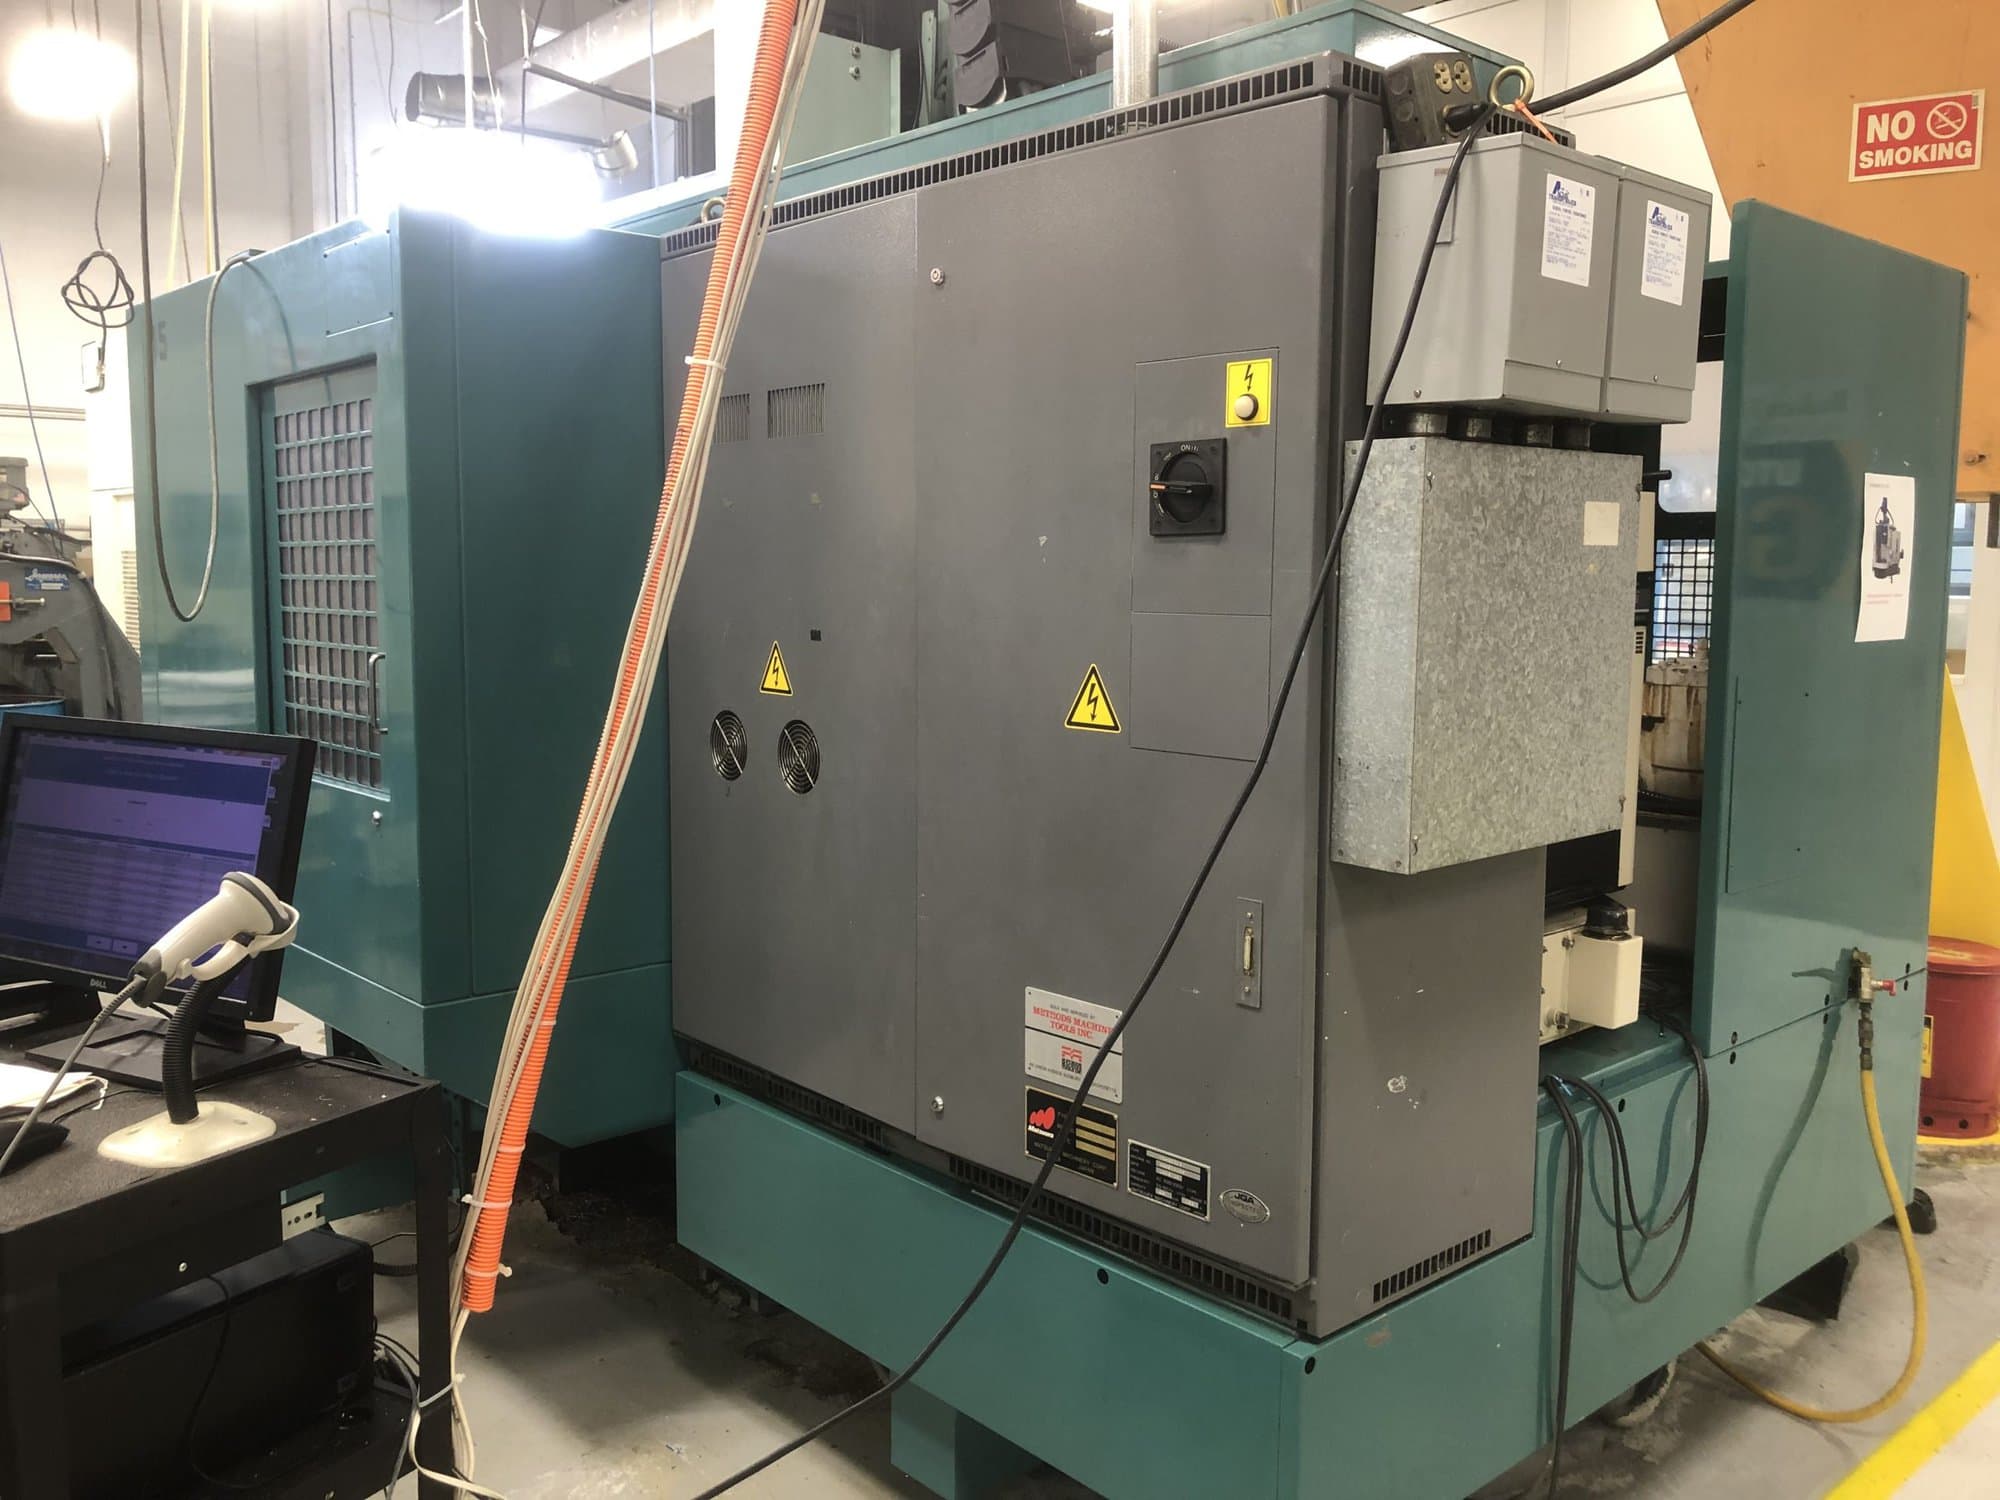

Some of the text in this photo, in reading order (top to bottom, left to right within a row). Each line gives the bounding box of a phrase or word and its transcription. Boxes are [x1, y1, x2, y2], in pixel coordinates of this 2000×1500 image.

[1866, 110, 1916, 144] NO
[1858, 140, 1973, 169] SMOKING
[1032, 1006, 1072, 1024] METHODS
[1049, 1021, 1076, 1034] TOOLS
